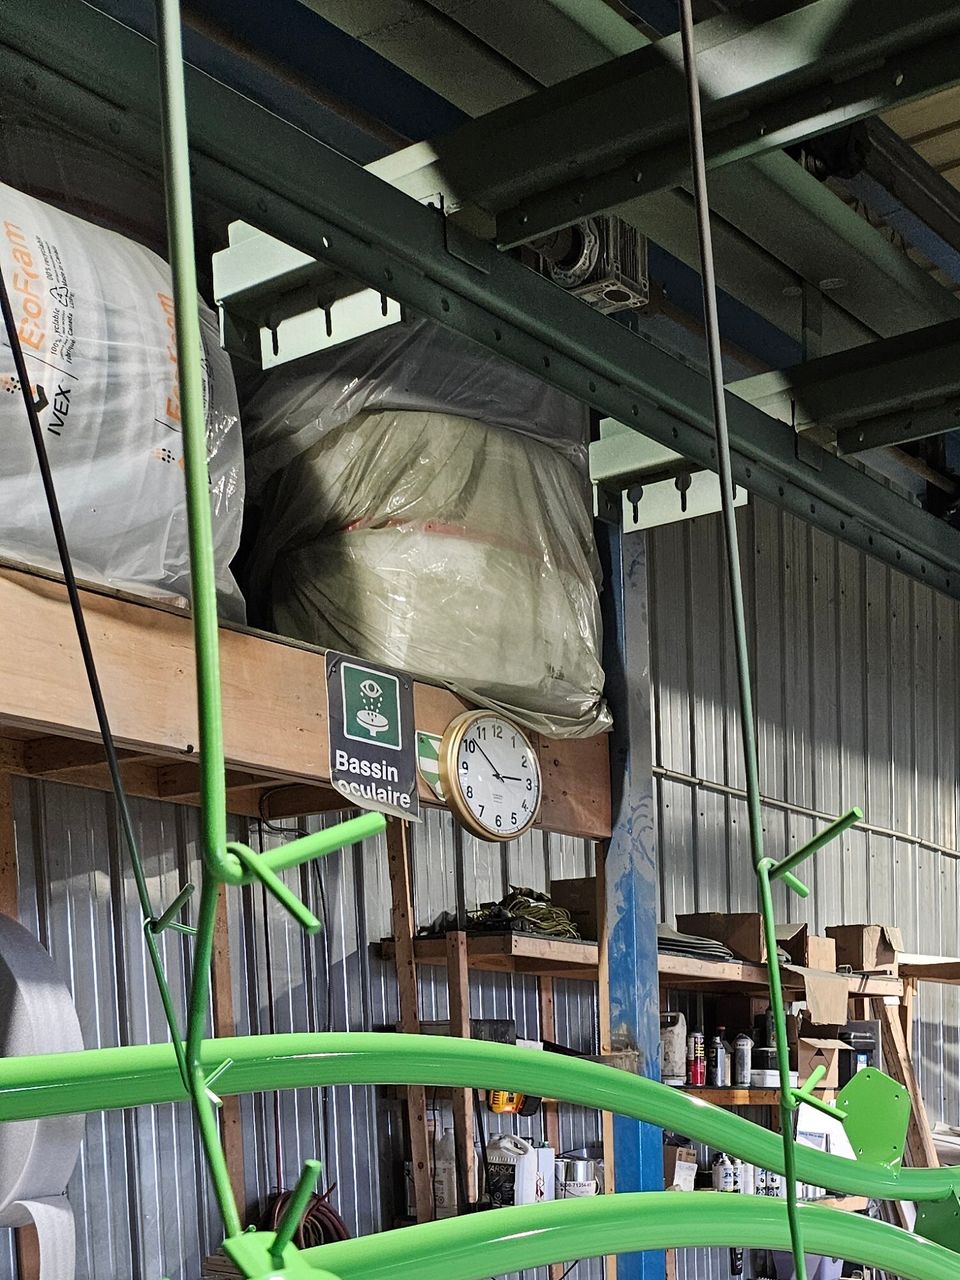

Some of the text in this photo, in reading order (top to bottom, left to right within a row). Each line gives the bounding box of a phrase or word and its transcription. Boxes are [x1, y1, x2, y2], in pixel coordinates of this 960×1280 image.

[47, 384, 71, 436] IVEX
[476, 726, 487, 740] 11
[492, 725, 502, 739] 12
[463, 739, 475, 753] 10
[511, 735, 516, 748] 1
[335, 749, 398, 783] Bassin
[521, 755, 527, 768] 2
[526, 778, 532, 791] 3
[337, 778, 411, 809] oculaire
[466, 785, 473, 799] 8
[478, 804, 485, 817] 7
[521, 799, 529, 812] 4
[495, 814, 502, 827] 6
[511, 812, 517, 825] 5
